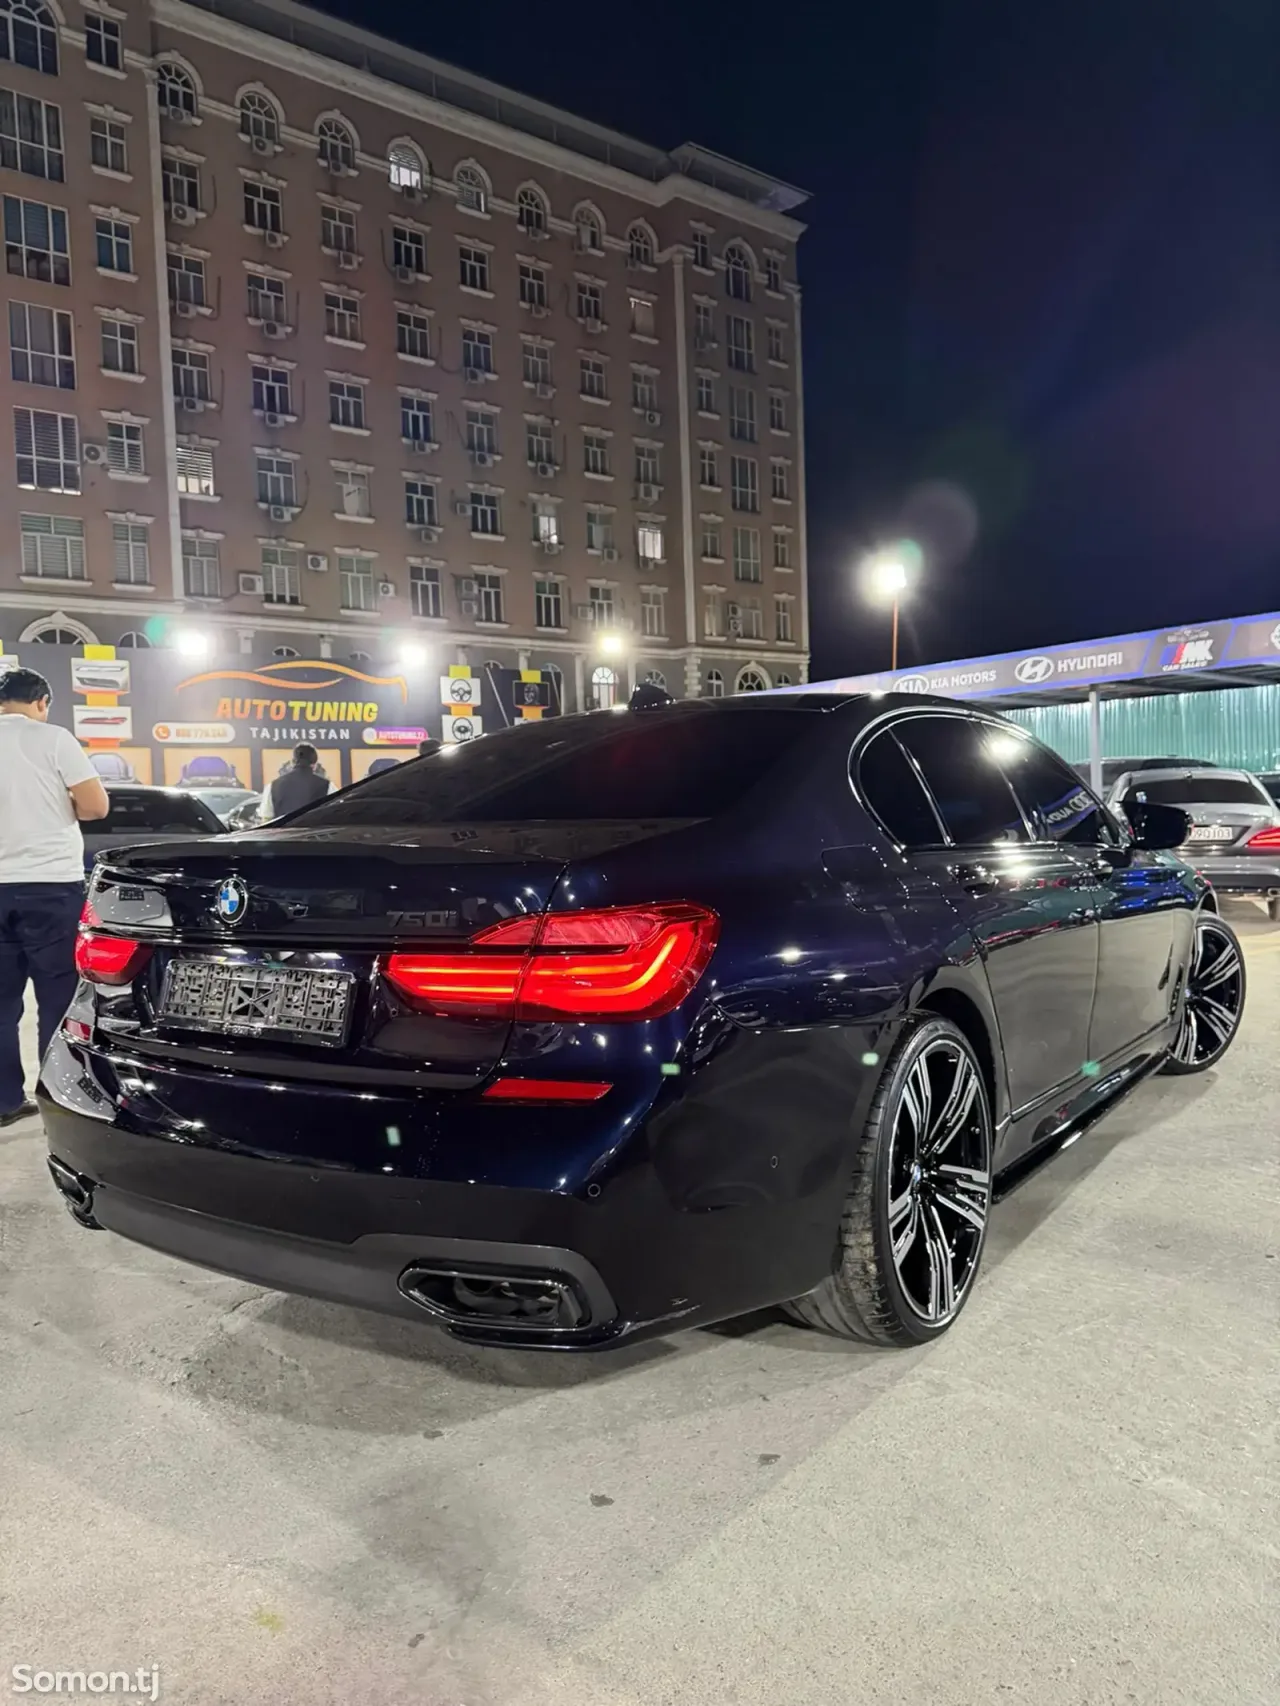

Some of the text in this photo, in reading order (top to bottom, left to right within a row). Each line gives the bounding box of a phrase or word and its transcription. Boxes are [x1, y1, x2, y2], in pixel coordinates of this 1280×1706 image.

[1057, 652, 1123, 673] HYUNDAI
[899, 679, 924, 693] KIA
[930, 670, 997, 689] KIA MOTORS
[250, 726, 350, 741] TAJIKISTAN
[386, 910, 457, 928] 750i
